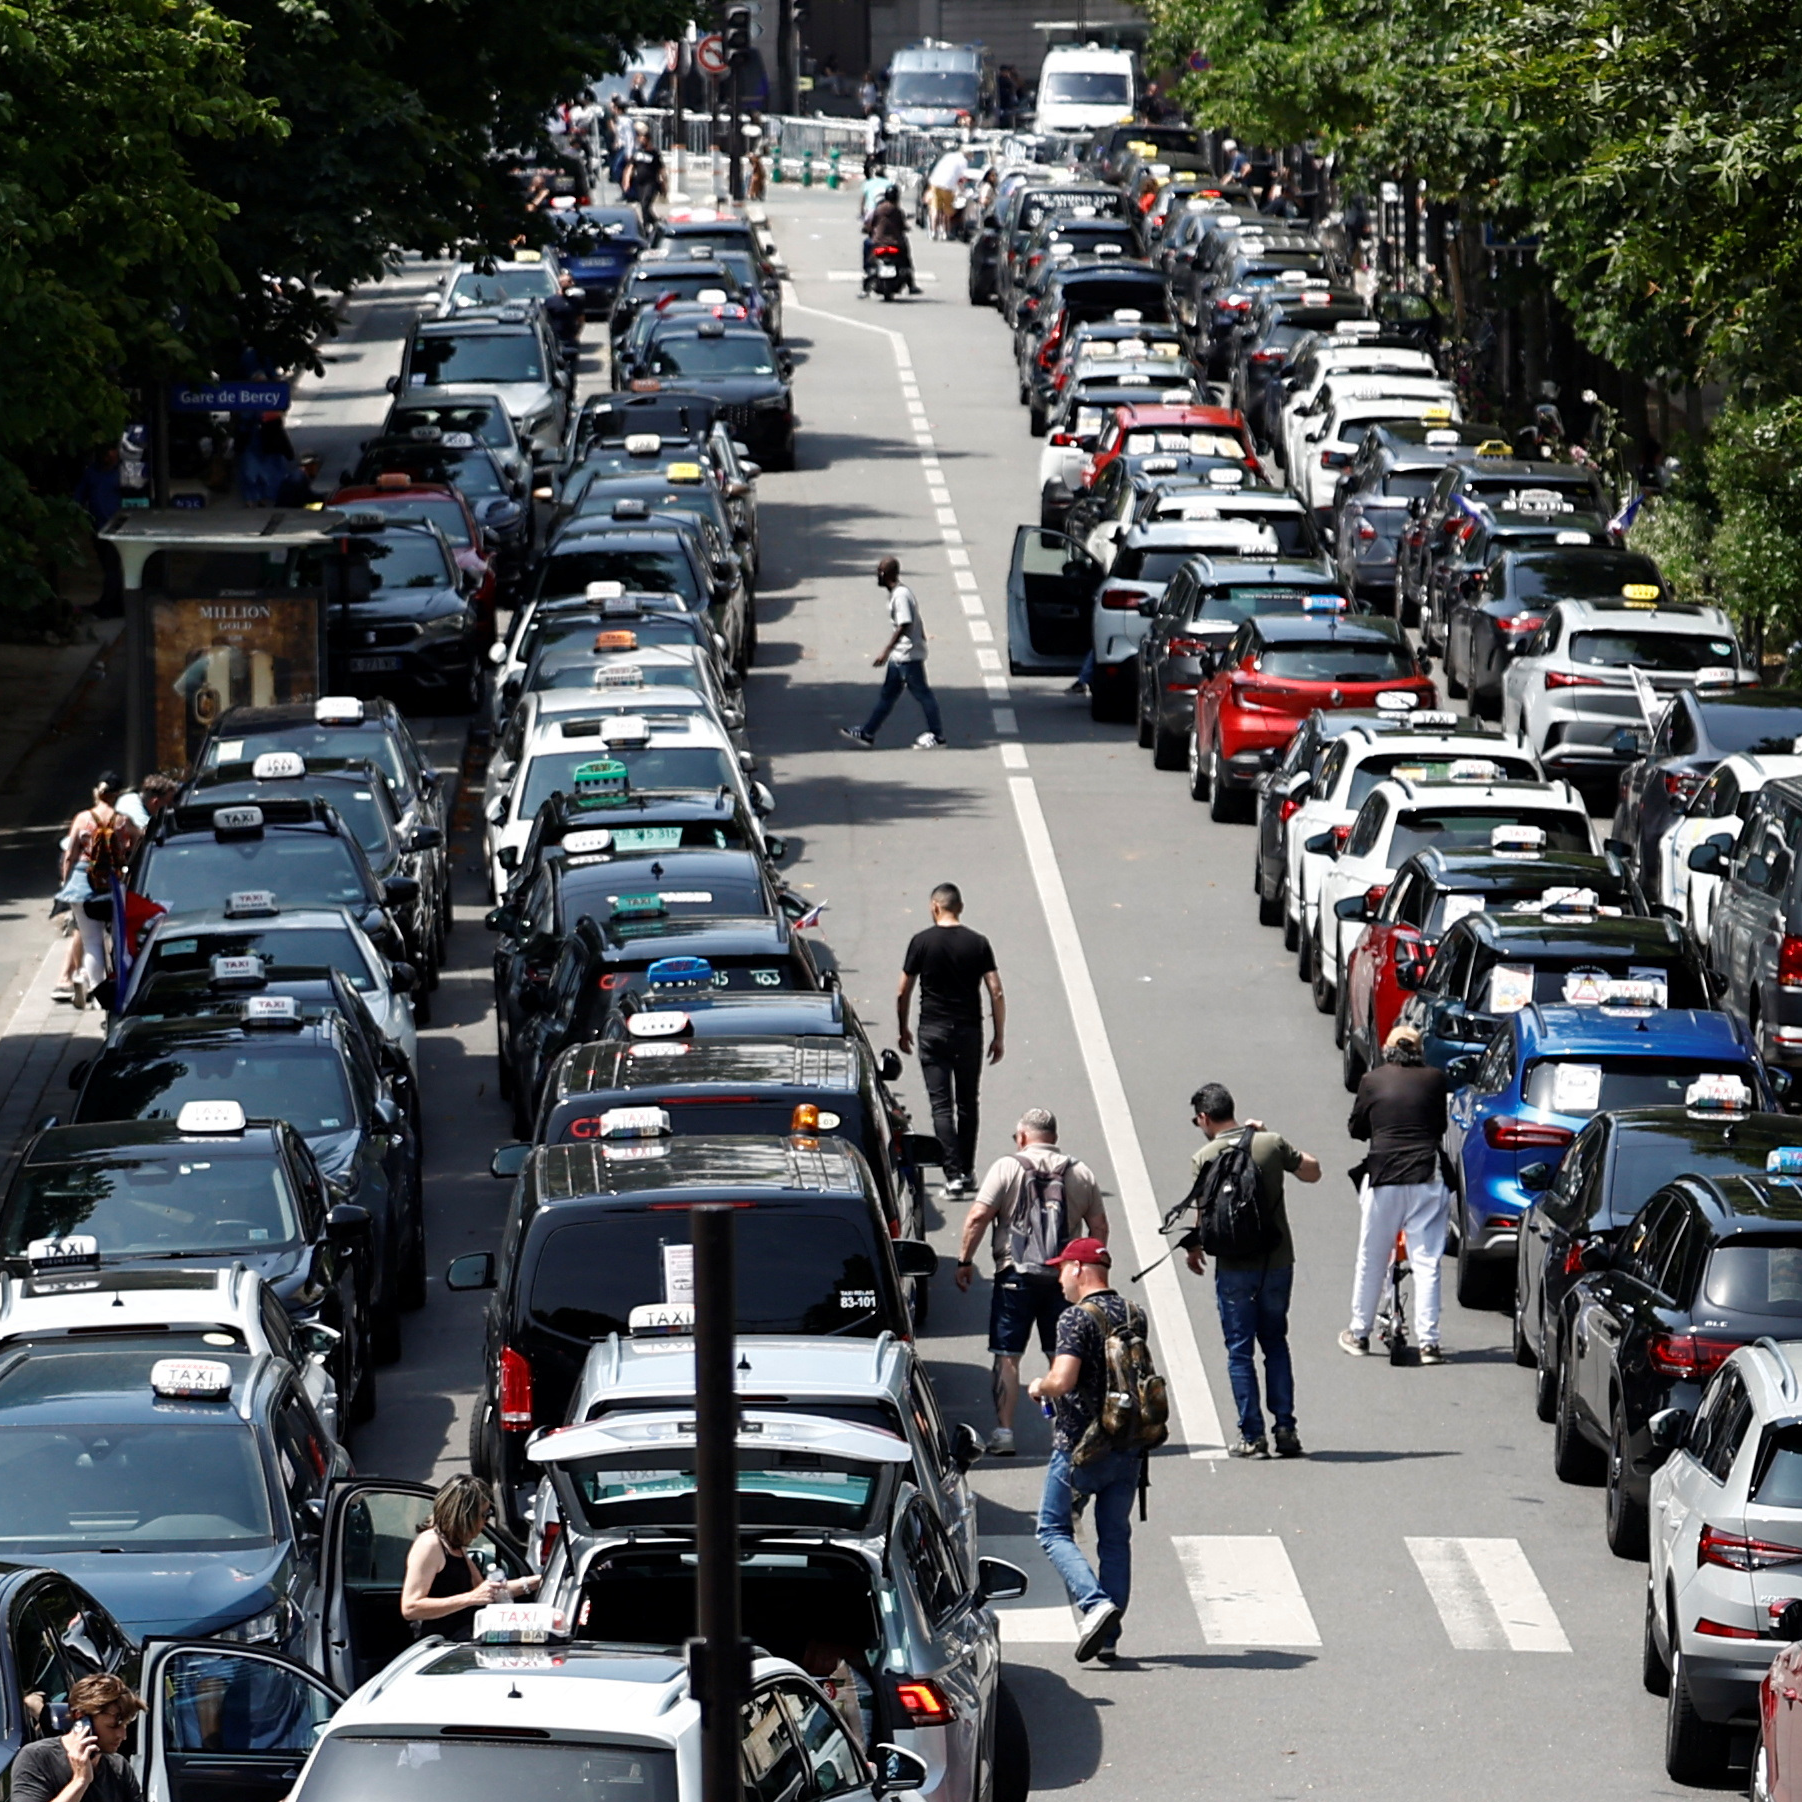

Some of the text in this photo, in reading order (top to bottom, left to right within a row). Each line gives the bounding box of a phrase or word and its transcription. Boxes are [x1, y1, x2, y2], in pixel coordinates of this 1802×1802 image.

[181, 391, 281, 407] Gare de Bercy
[200, 606, 271, 619] MILLION
[218, 621, 252, 631] GOLD
[224, 813, 254, 823] TAXI
[239, 894, 264, 902] TAXI
[625, 898, 652, 906] TAXI
[257, 1000, 286, 1008] TAXI
[1707, 1086, 1735, 1095] TAXI
[619, 1112, 652, 1122] TAXI
[43, 1241, 85, 1258] TAXI
[840, 1296, 876, 1308] 83-101
[646, 1311, 693, 1325] TAXI
[170, 1369, 214, 1381] TAXI
[498, 1611, 538, 1622] TAXI
